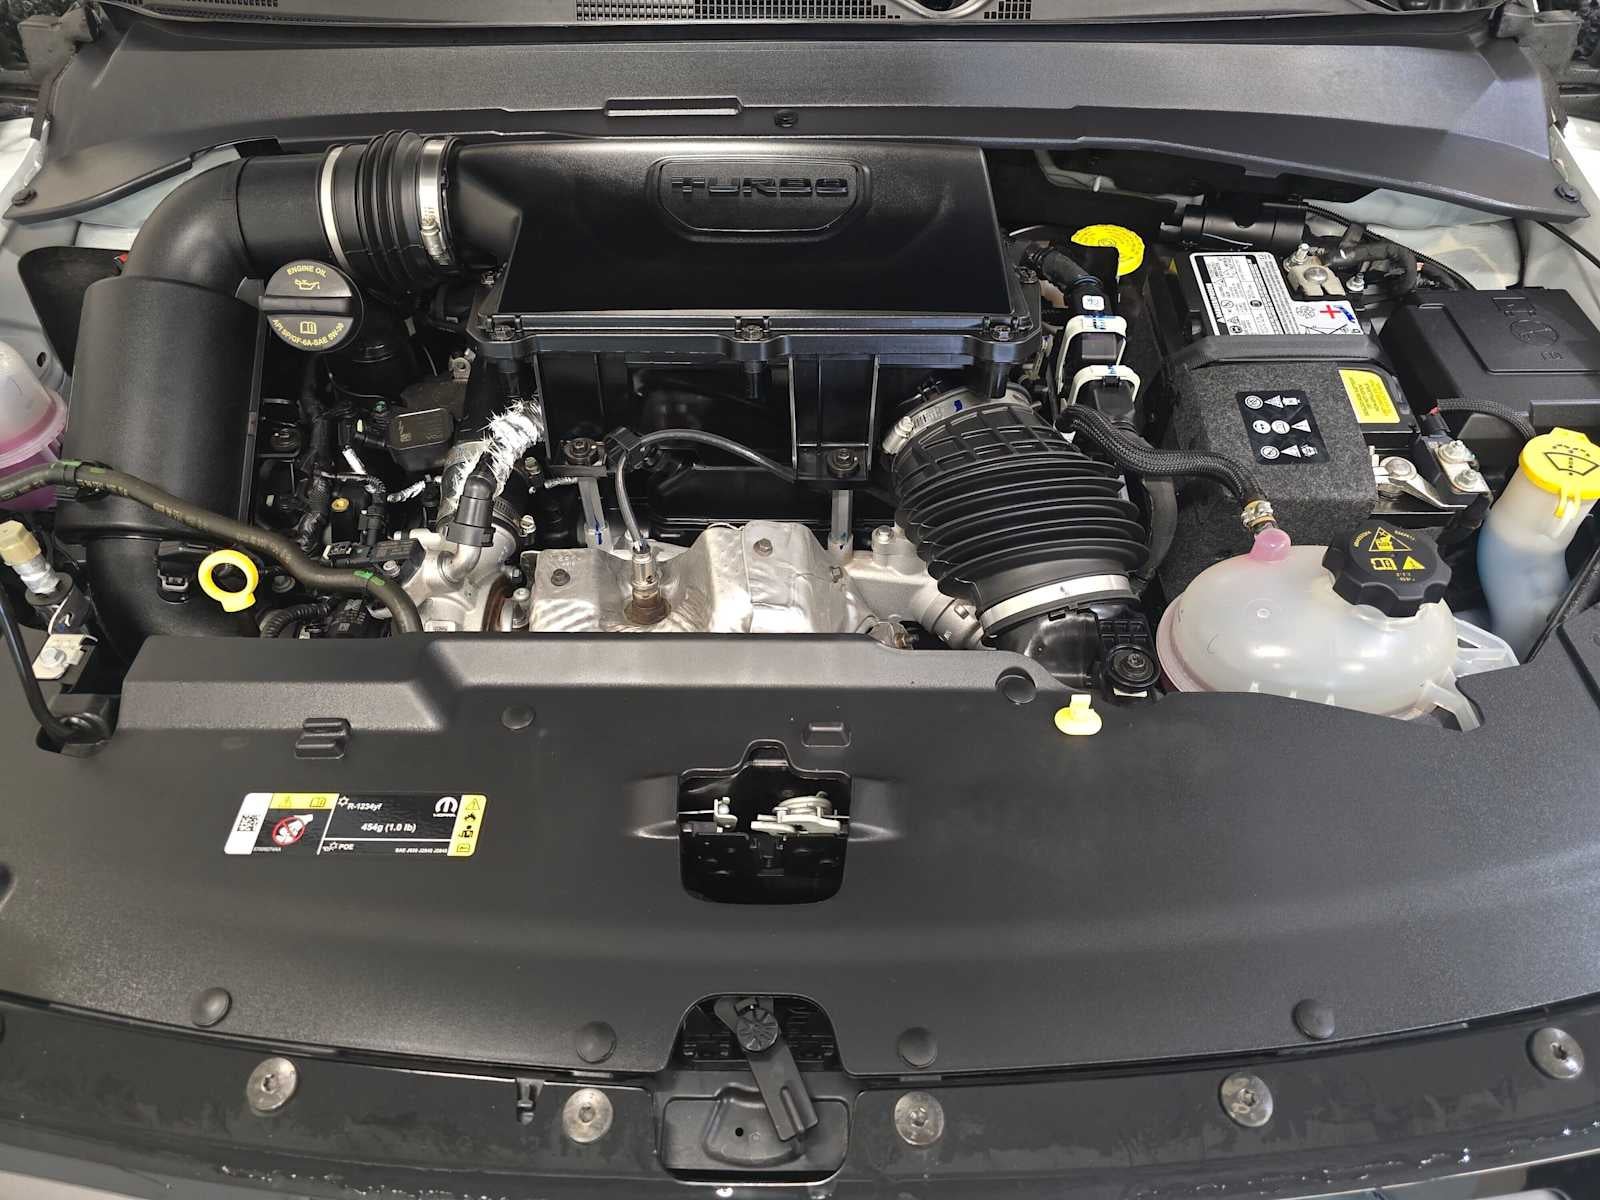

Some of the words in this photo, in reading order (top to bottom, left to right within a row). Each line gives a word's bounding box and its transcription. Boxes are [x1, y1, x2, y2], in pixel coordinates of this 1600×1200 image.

[671, 176, 849, 197] TURBO
[287, 264, 314, 276] ENGINE
[315, 267, 328, 278] OIL
[272, 319, 283, 331] API
[347, 802, 383, 812] R-1234yf
[360, 823, 384, 833] 454g
[385, 823, 402, 833] (1.0
[403, 823, 417, 833] lb)
